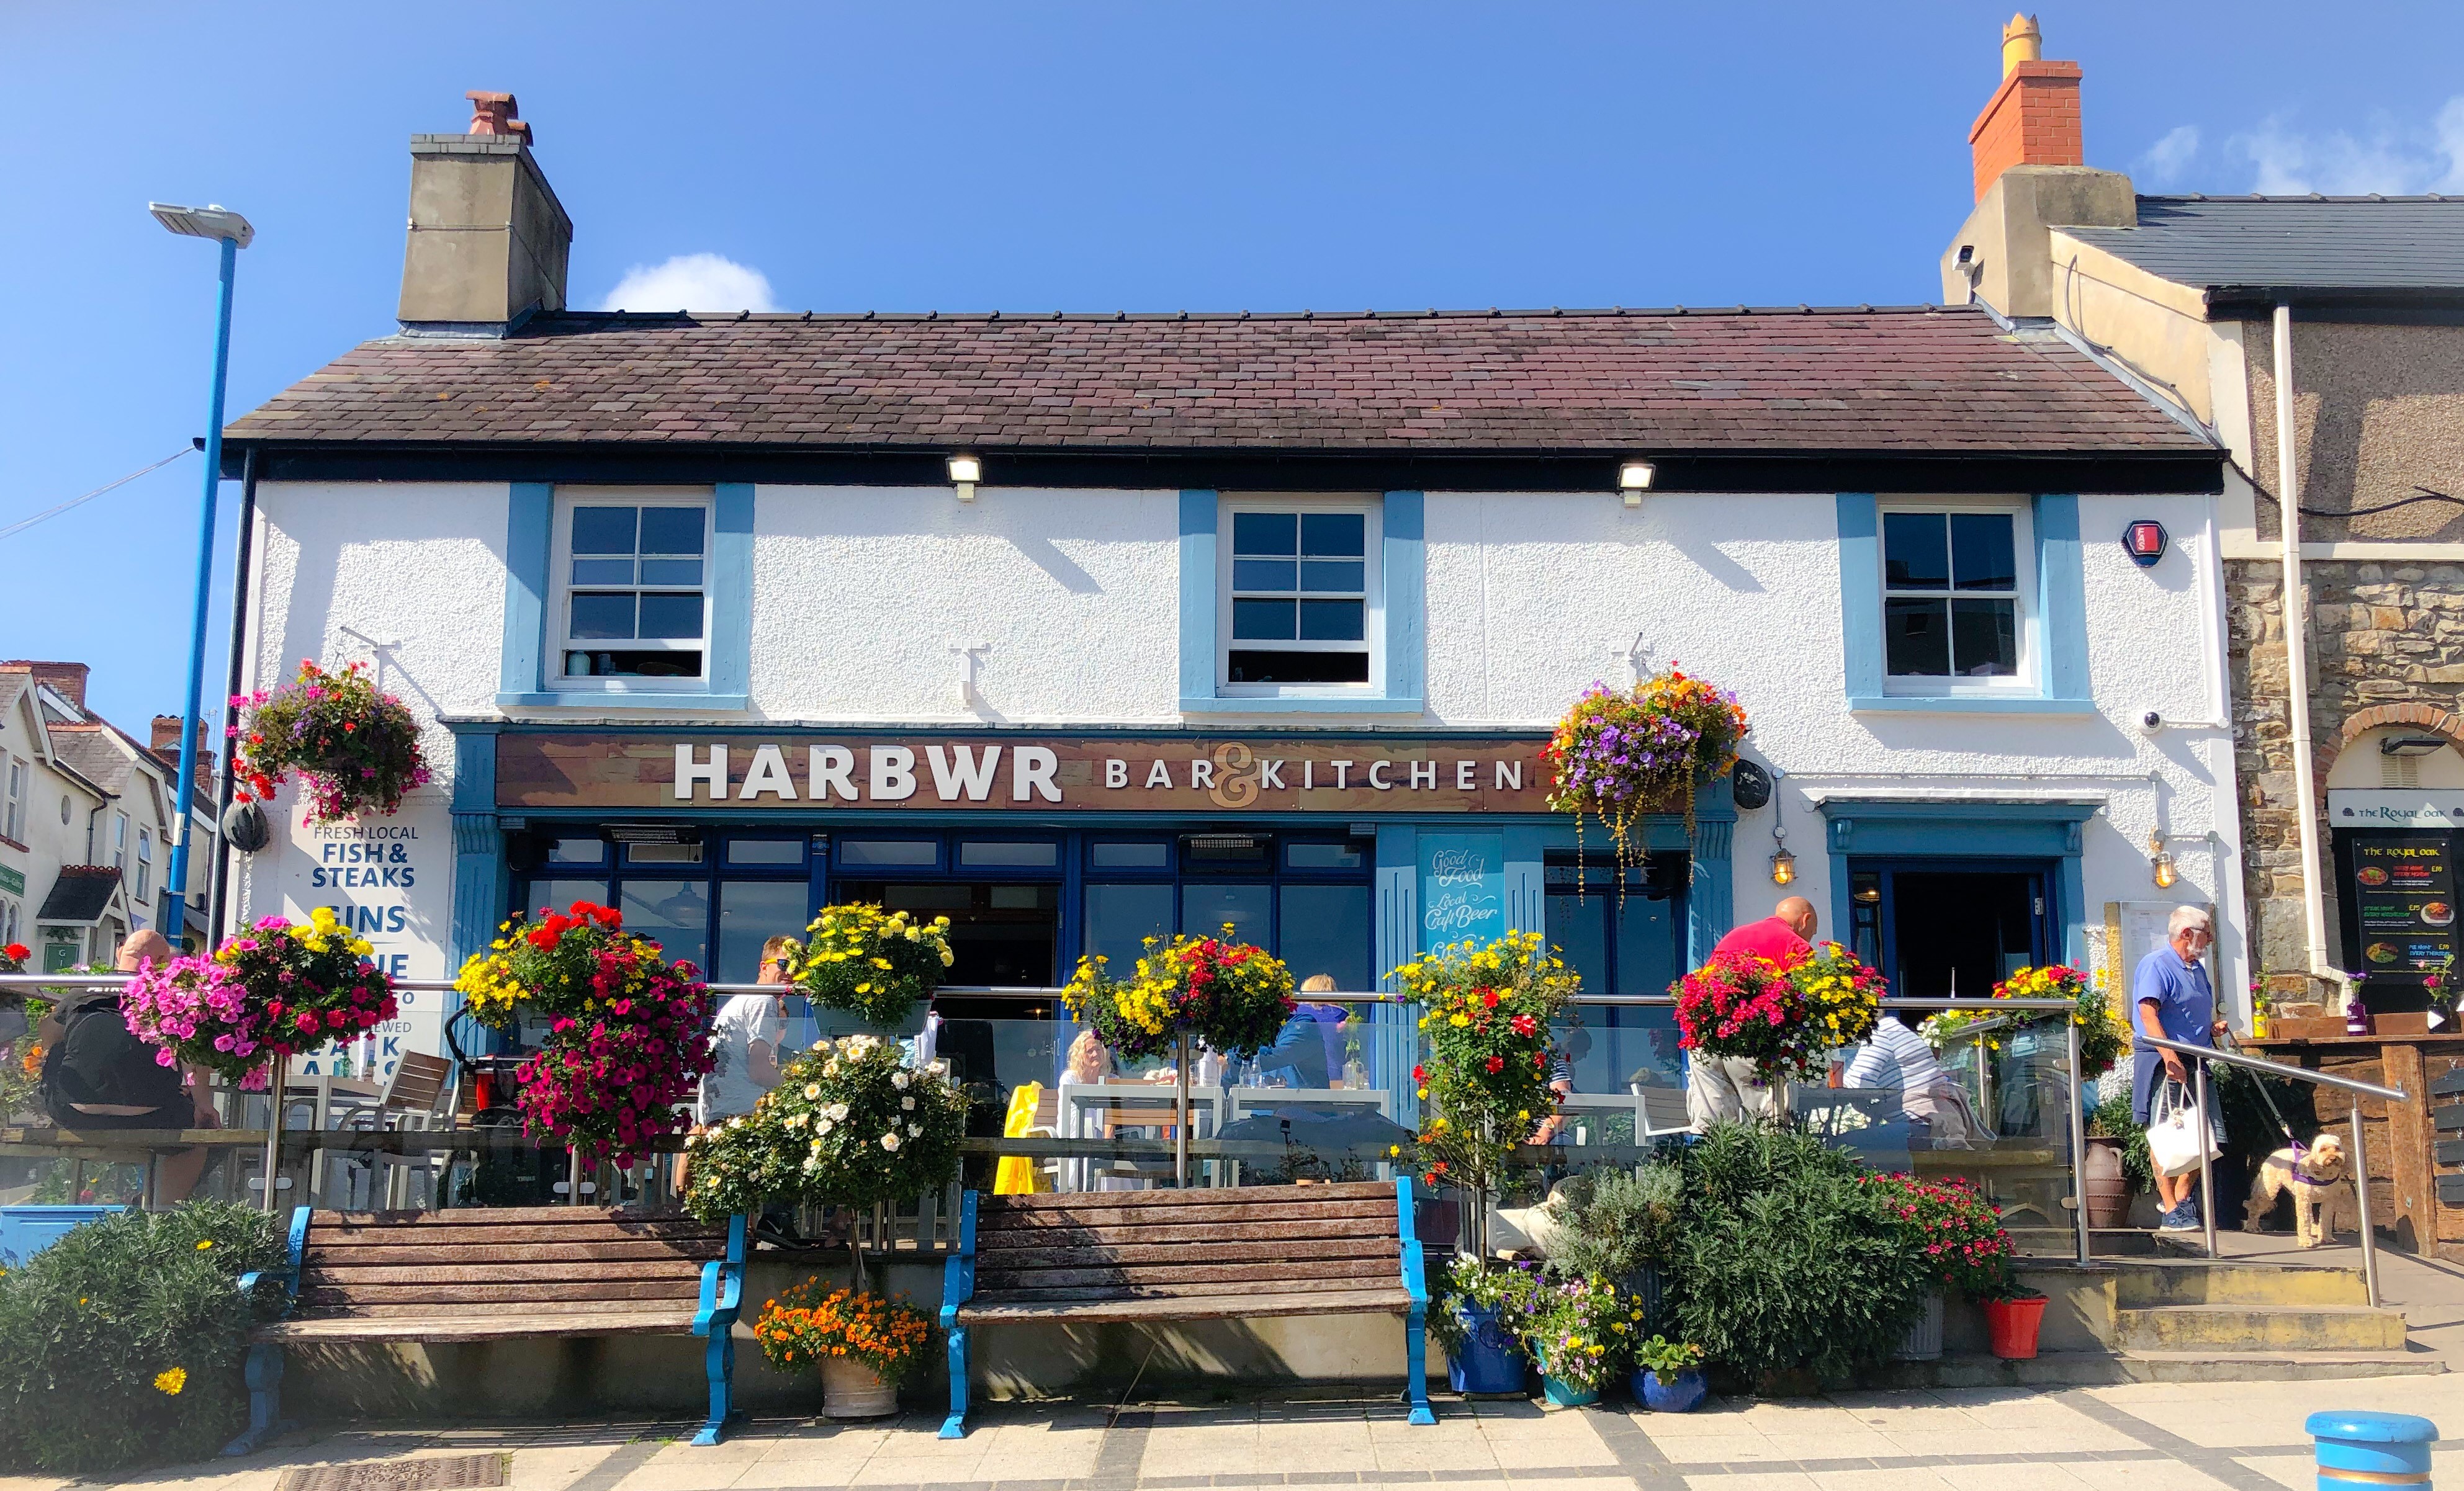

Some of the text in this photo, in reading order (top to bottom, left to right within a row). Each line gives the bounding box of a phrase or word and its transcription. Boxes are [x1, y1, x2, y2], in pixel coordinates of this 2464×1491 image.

[2137, 527, 2145, 550] FAS
[675, 742, 1522, 808] HARBWR BAR & KITCHEN
[314, 826, 419, 840] FRESH LOCAL
[323, 843, 407, 864] FISH &
[1432, 849, 1469, 877] Good
[312, 867, 415, 888] STEAKS
[1439, 857, 1485, 887] Food
[1436, 890, 1468, 911] Local
[1424, 905, 1498, 933] Craft Beer
